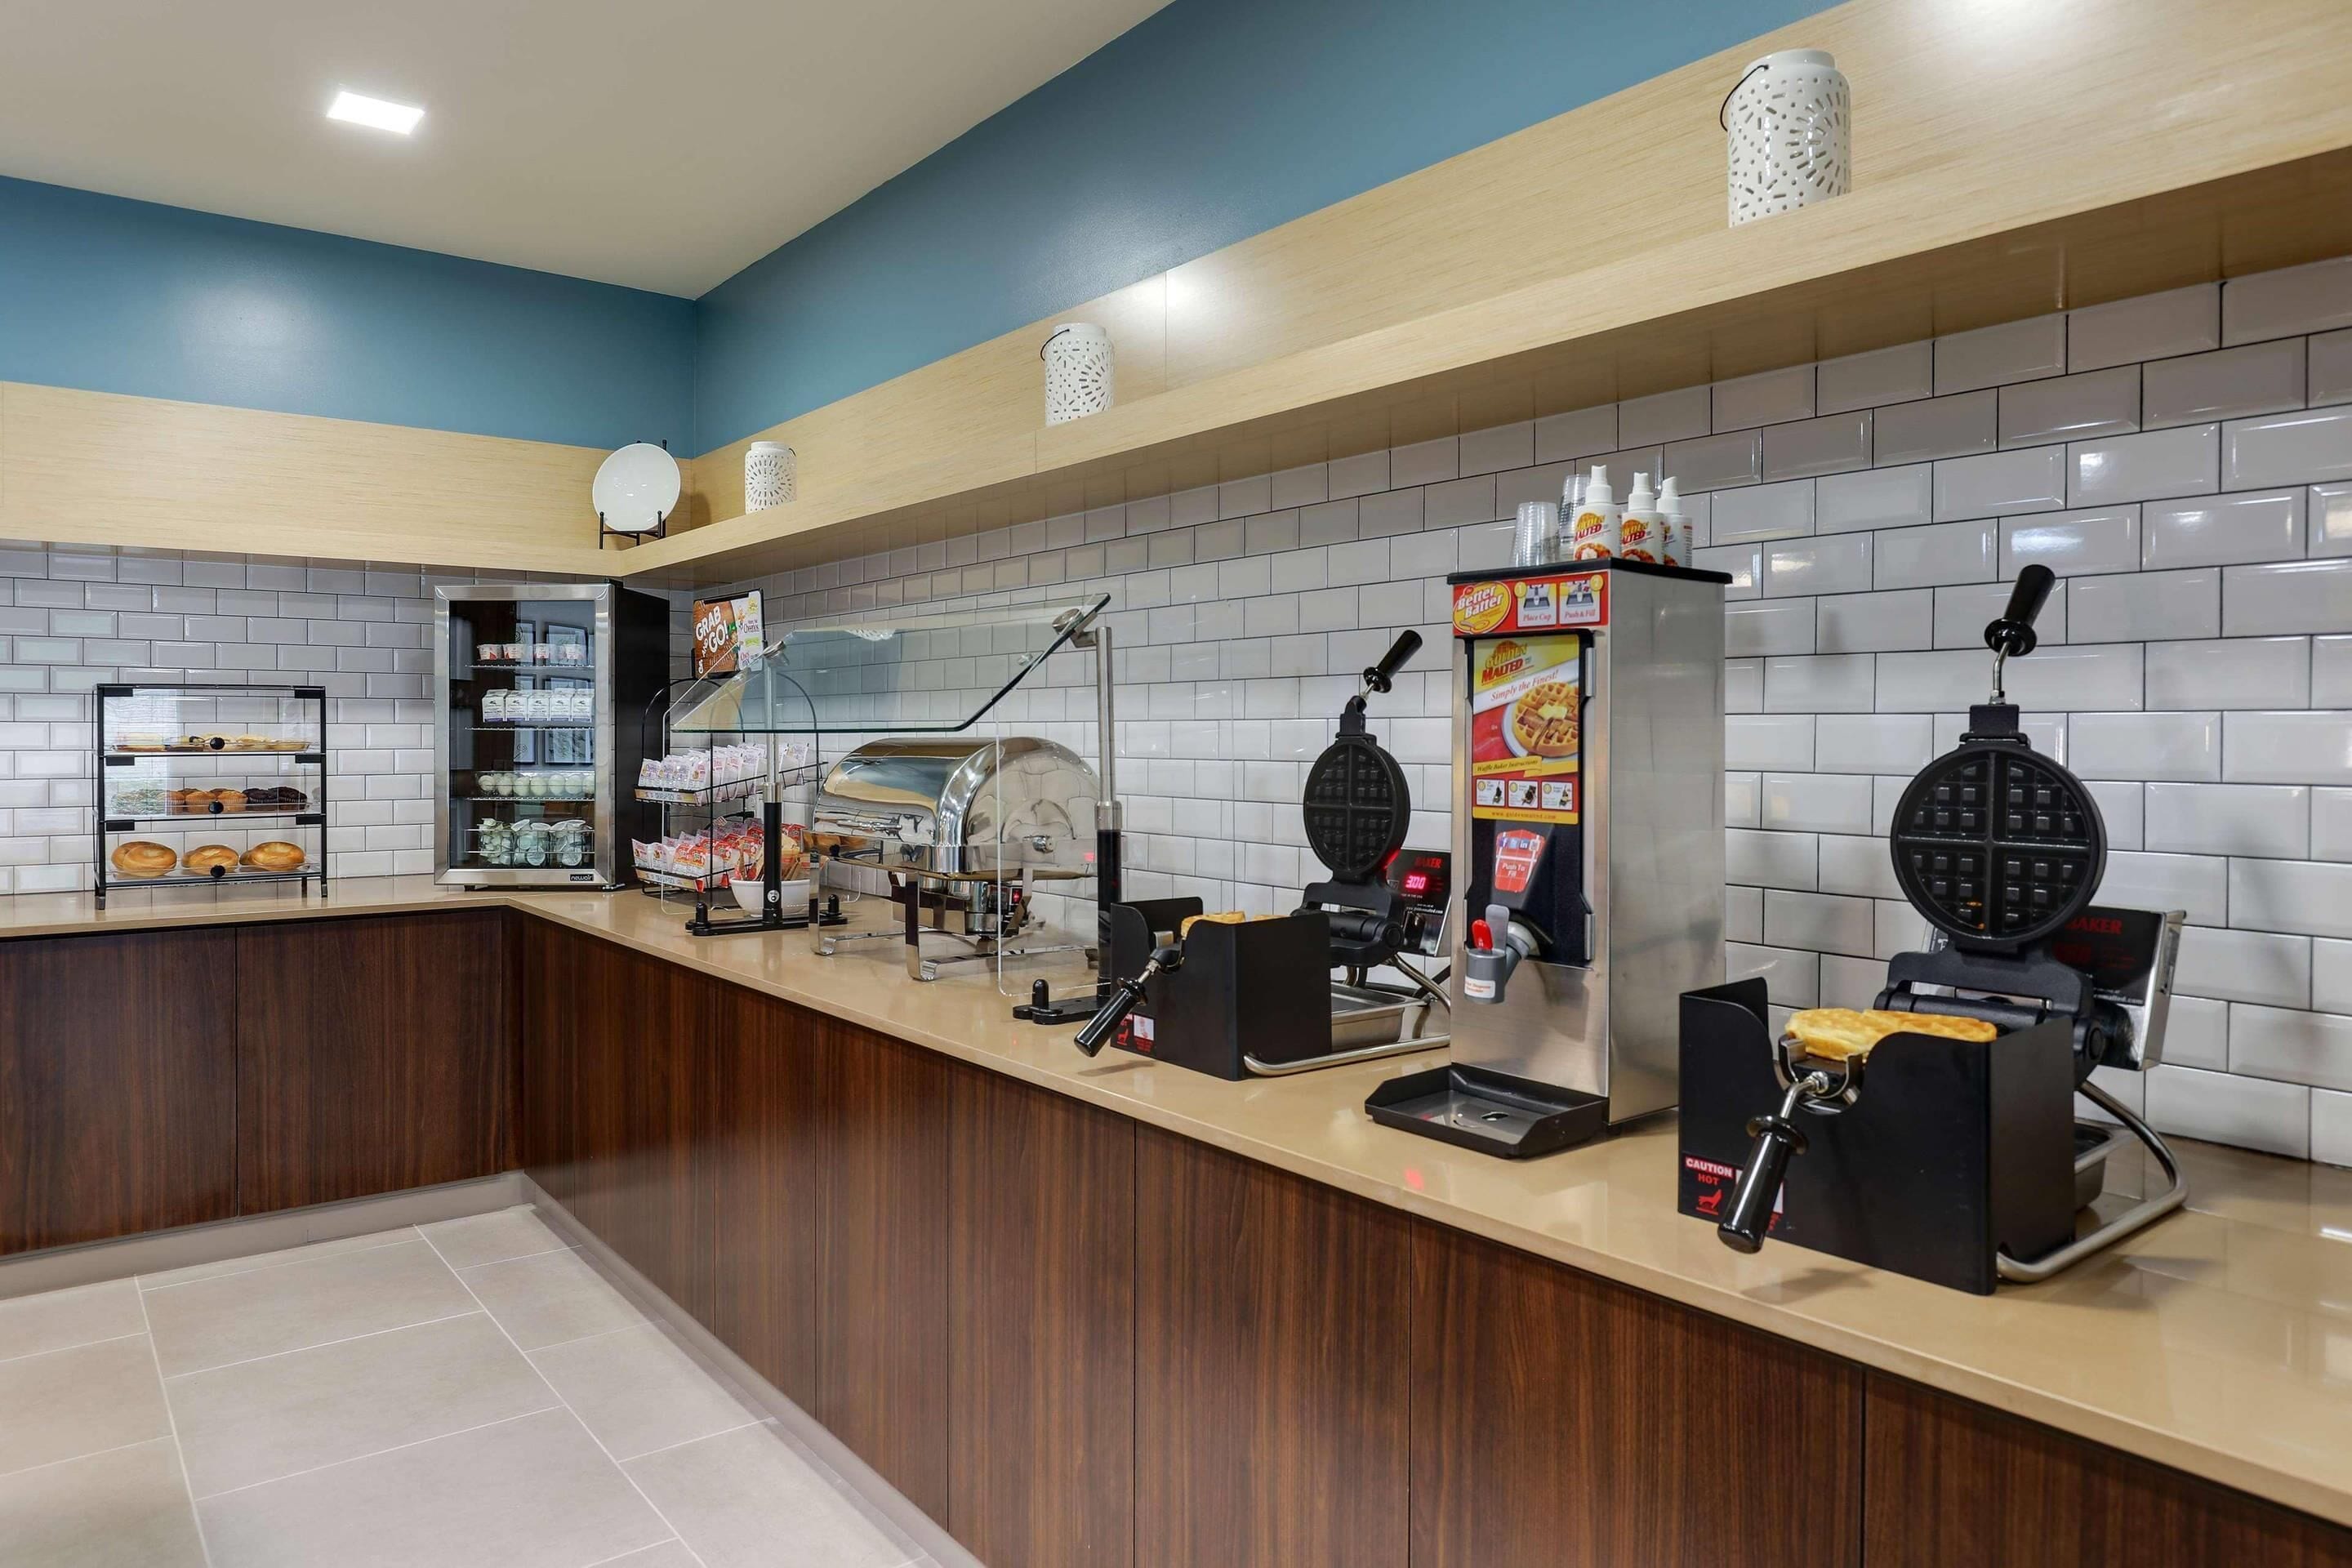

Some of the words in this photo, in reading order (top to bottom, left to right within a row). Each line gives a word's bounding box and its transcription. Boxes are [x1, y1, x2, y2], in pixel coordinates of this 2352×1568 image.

[1457, 585, 1497, 611] Better
[1464, 594, 1504, 620] Batter
[696, 605, 721, 640] GRAB
[1523, 613, 1537, 621] Place
[1539, 612, 1552, 622] Cup
[709, 619, 729, 653] GO!
[1482, 657, 1524, 684] MALTED
[1490, 684, 1517, 702] Simply
[1518, 681, 1531, 692] the
[1532, 669, 1559, 687] Finest!
[1405, 875, 1427, 889] 300
[1685, 1157, 1733, 1178] CAUTION
[1698, 1174, 1720, 1186] HOT
